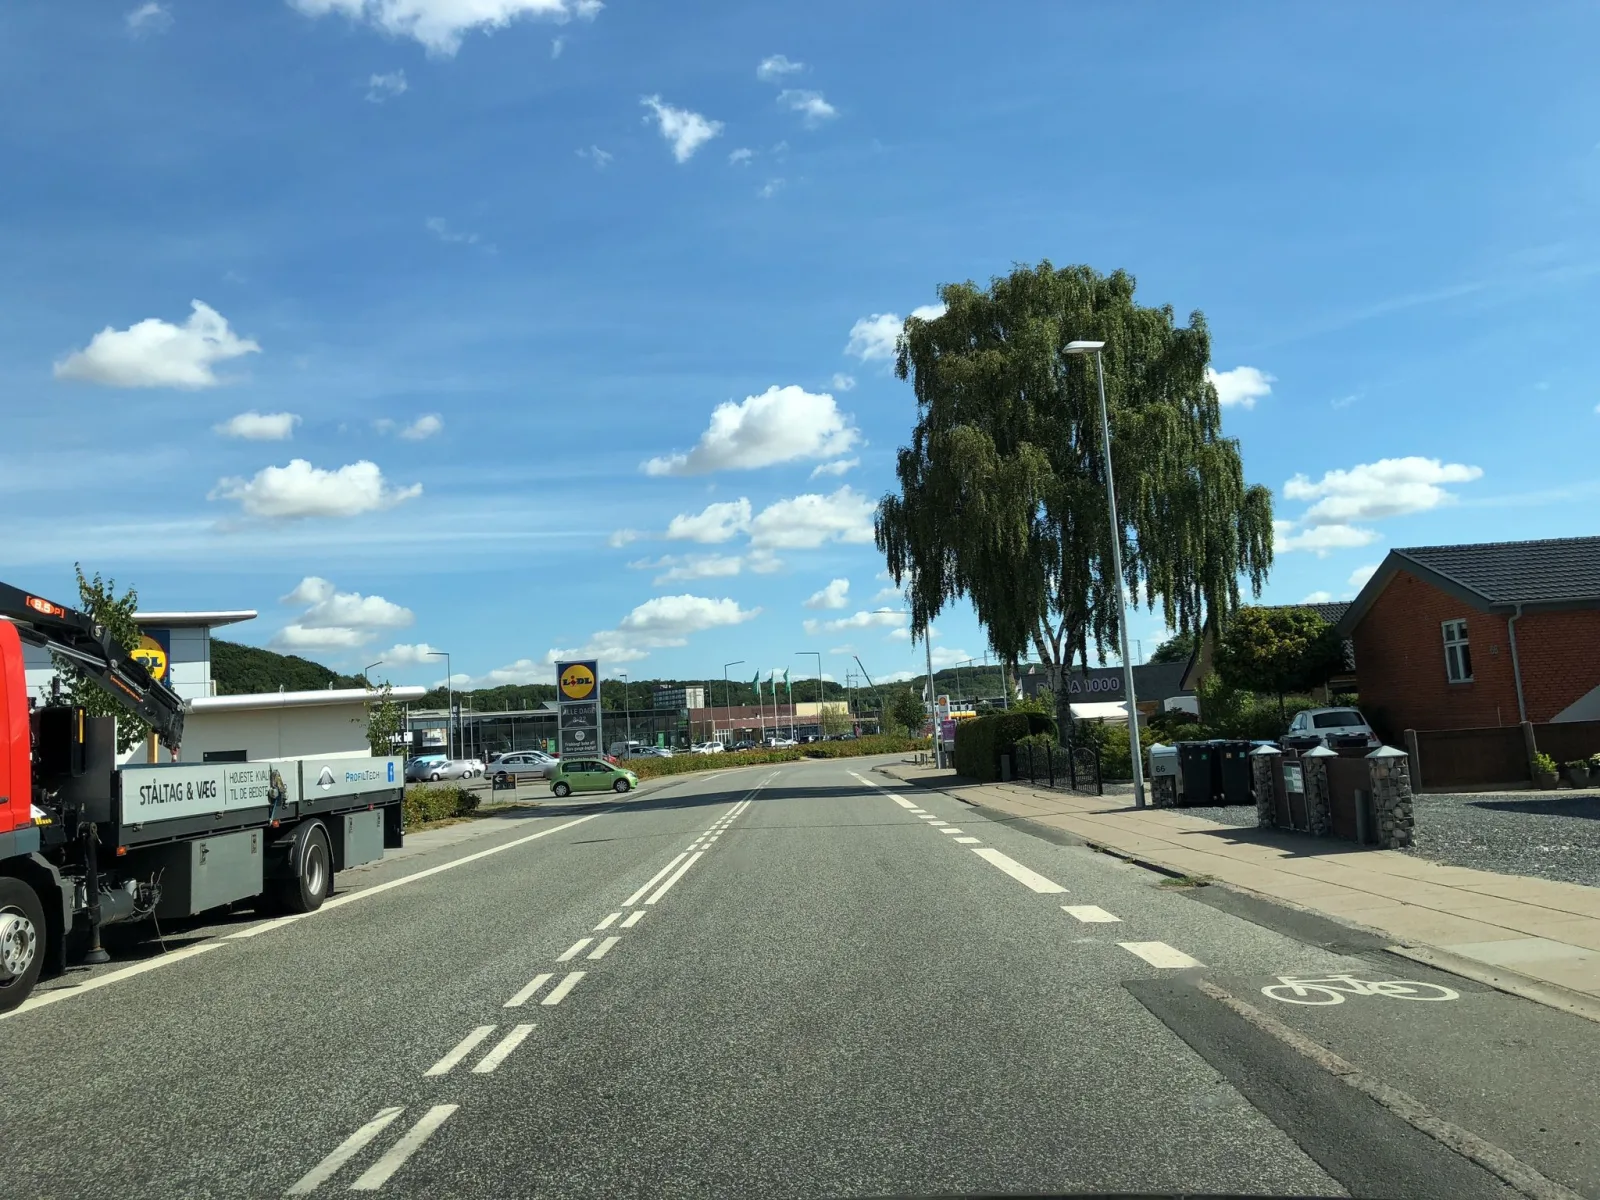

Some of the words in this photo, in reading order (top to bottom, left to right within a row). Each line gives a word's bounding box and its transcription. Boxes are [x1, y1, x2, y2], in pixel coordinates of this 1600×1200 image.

[1084, 677, 1120, 692] 1000
[1155, 765, 1166, 773] 66
[229, 770, 254, 784] HØJESTE
[140, 778, 183, 806] STÅLTAG
[186, 781, 194, 801] &
[196, 780, 217, 799] VÆG
[230, 788, 238, 801] TIL
[240, 787, 248, 799] DE
[249, 785, 268, 799] BEDSTE
